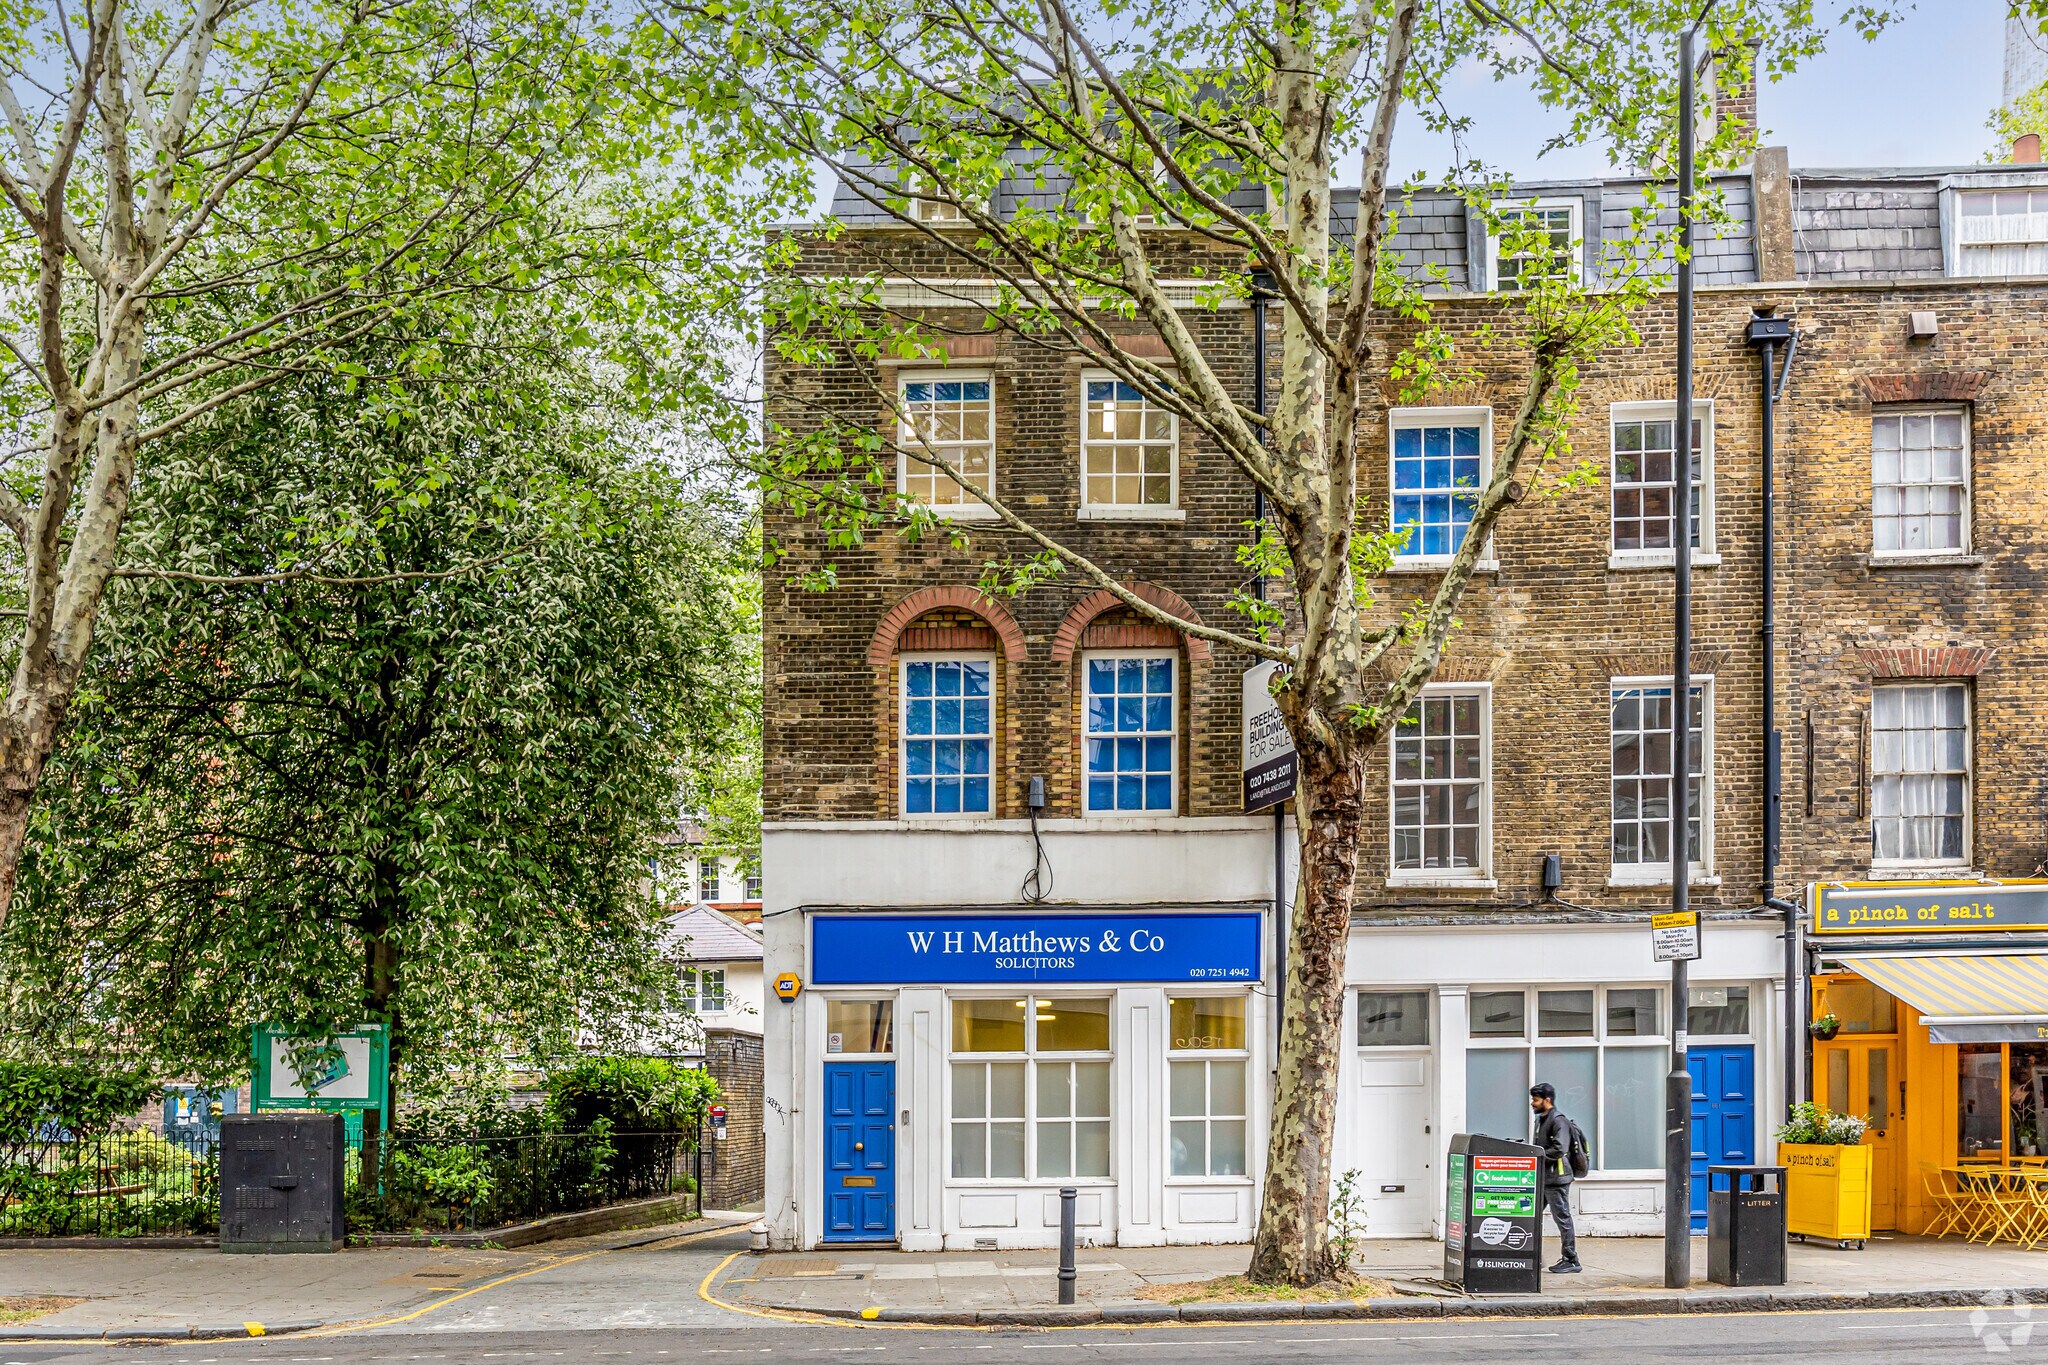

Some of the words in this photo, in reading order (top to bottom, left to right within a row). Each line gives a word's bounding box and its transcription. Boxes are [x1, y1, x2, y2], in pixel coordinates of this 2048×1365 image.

[1250, 707, 1284, 730] FREEHOL
[1250, 719, 1284, 744] BUILDING
[1250, 740, 1266, 760] FOR
[1269, 731, 1290, 752] SALE
[1250, 775, 1261, 788] 020
[1263, 769, 1277, 784] 7438
[1278, 763, 1290, 777] 2011
[1826, 908, 1839, 921] a
[1848, 905, 1908, 924] pinch
[1918, 904, 1940, 920] of
[1949, 903, 1995, 919] salt
[906, 931, 936, 953] W
[942, 931, 964, 953] H
[972, 930, 1090, 953] Matthews
[1098, 930, 1122, 952] &
[1130, 929, 1164, 952] Co
[996, 957, 1075, 968] SOLICITORS
[1190, 969, 1205, 977] 020
[1208, 968, 1227, 976] 7251
[1229, 968, 1250, 976] 4942
[1787, 1154, 1792, 1162] a
[1792, 1154, 1813, 1166] pinch
